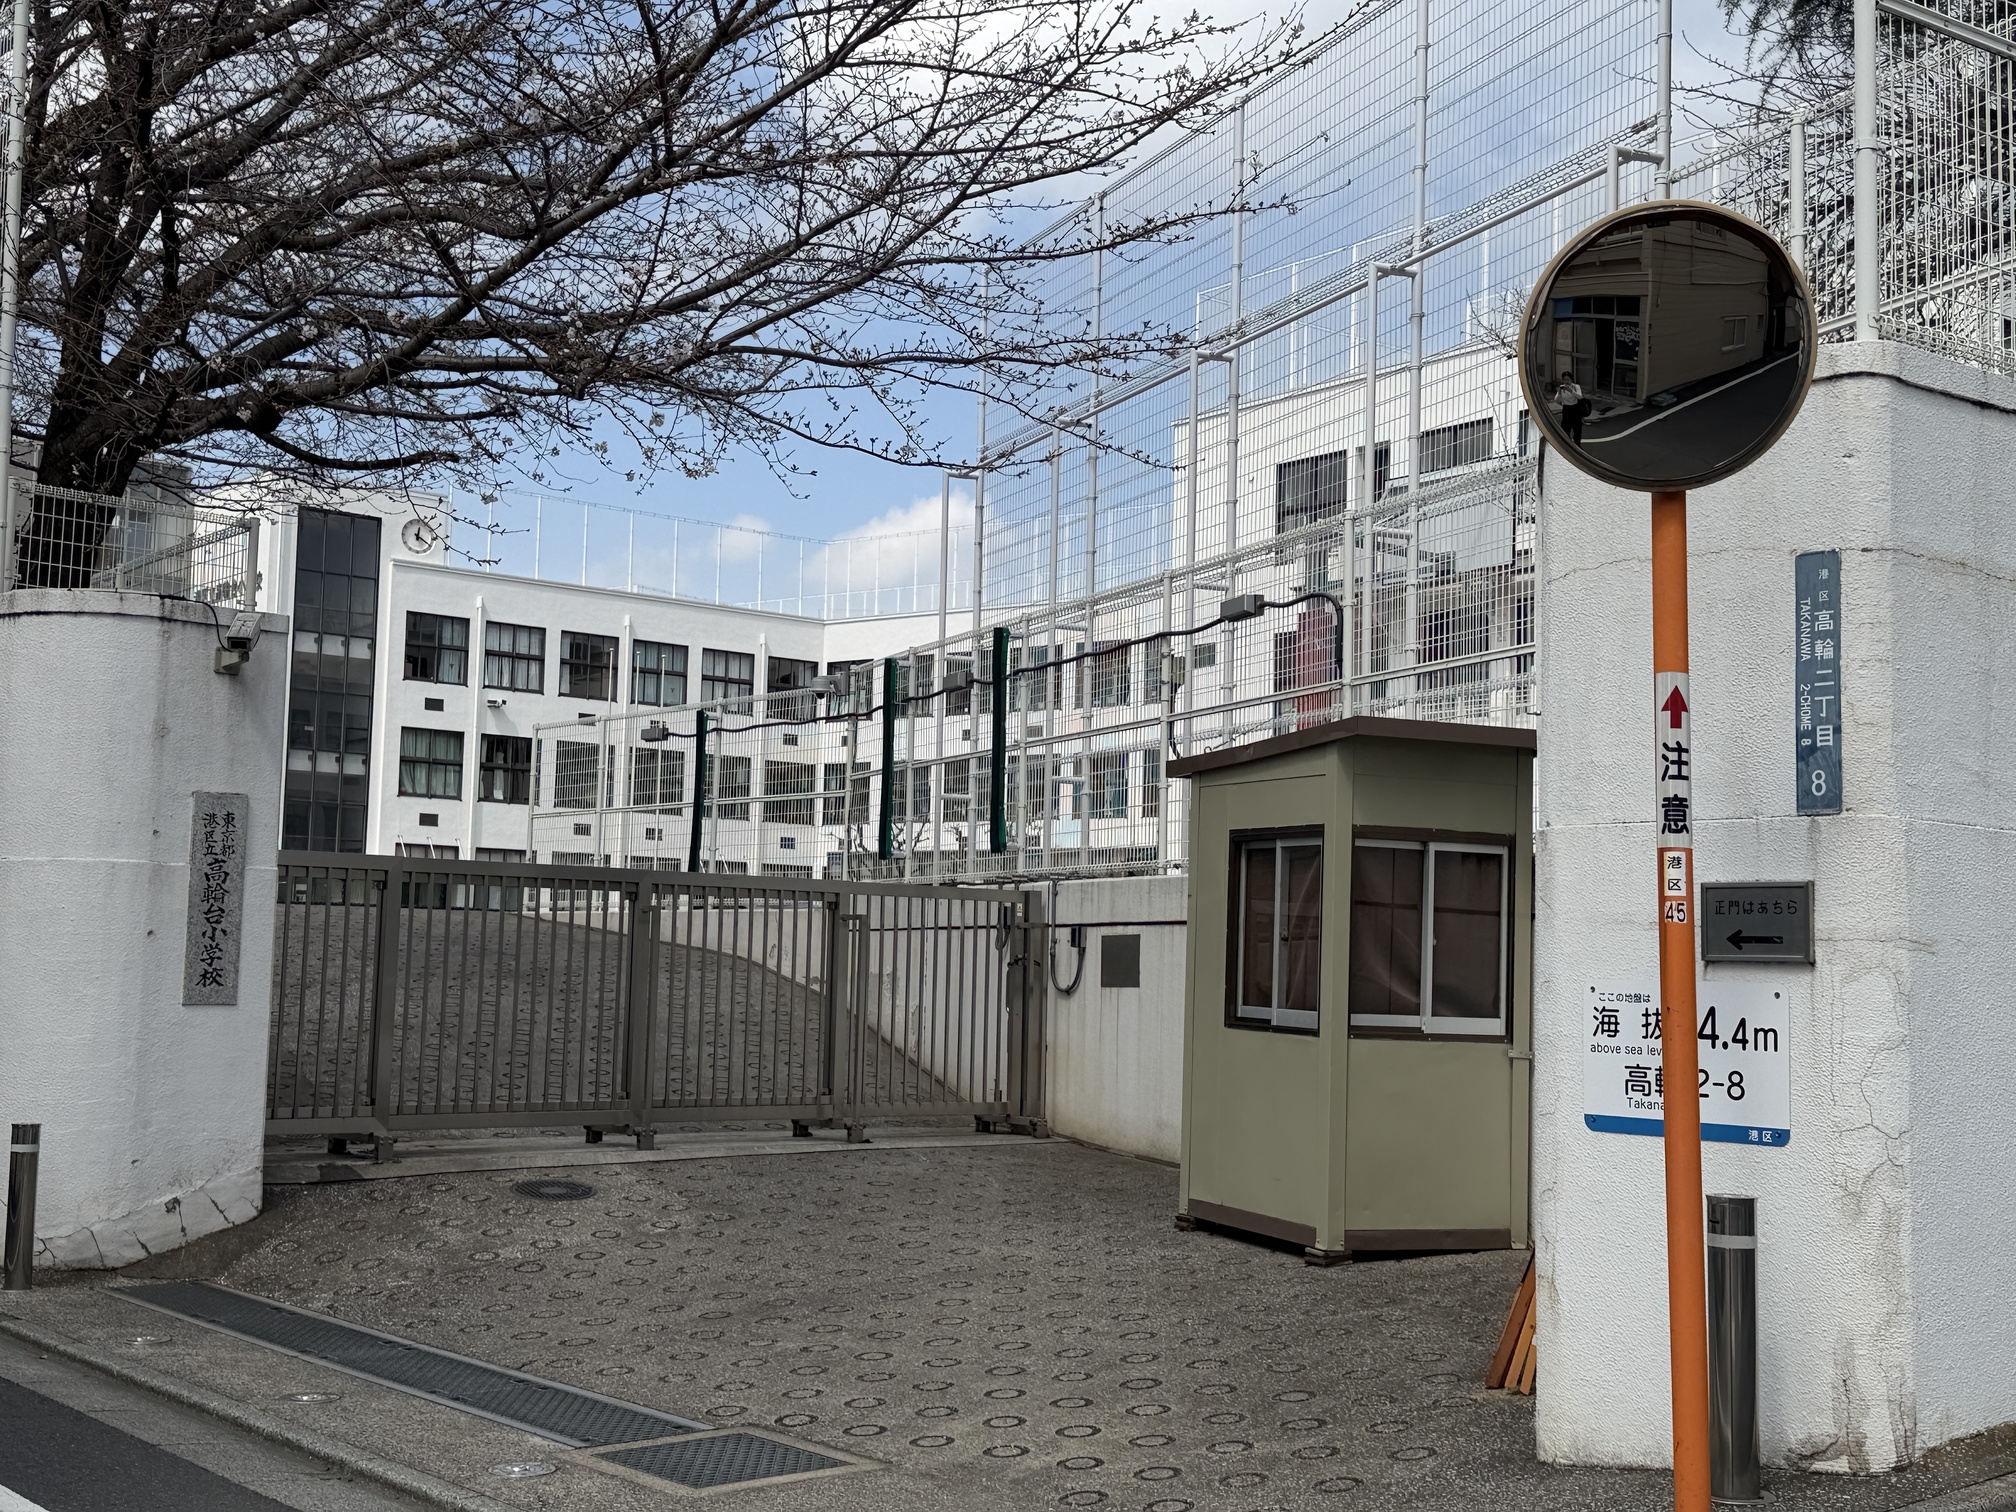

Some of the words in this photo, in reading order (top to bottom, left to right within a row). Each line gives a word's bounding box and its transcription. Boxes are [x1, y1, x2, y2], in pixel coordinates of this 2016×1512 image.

[1800, 597, 1812, 662] TAKANAWA
[1800, 683, 1812, 731] 2-CHOME
[1801, 738, 1812, 746] 8
[1661, 740, 1690, 834] 注意
[1810, 769, 1827, 797] 8
[202, 812, 220, 857] 港区立
[219, 811, 237, 858] 東京都
[1667, 855, 1682, 891] 港区
[195, 858, 230, 987] 高輪台小学校
[1665, 902, 1686, 922] 45
[1714, 900, 1798, 916] 正門はあちら
[1598, 992, 1651, 1004] ここの地盤は
[1590, 1042, 1622, 1055] above
[1624, 1045, 1643, 1056] sea
[1698, 1068, 1746, 1102] 2-8
[1748, 1129, 1773, 1143] 港区
